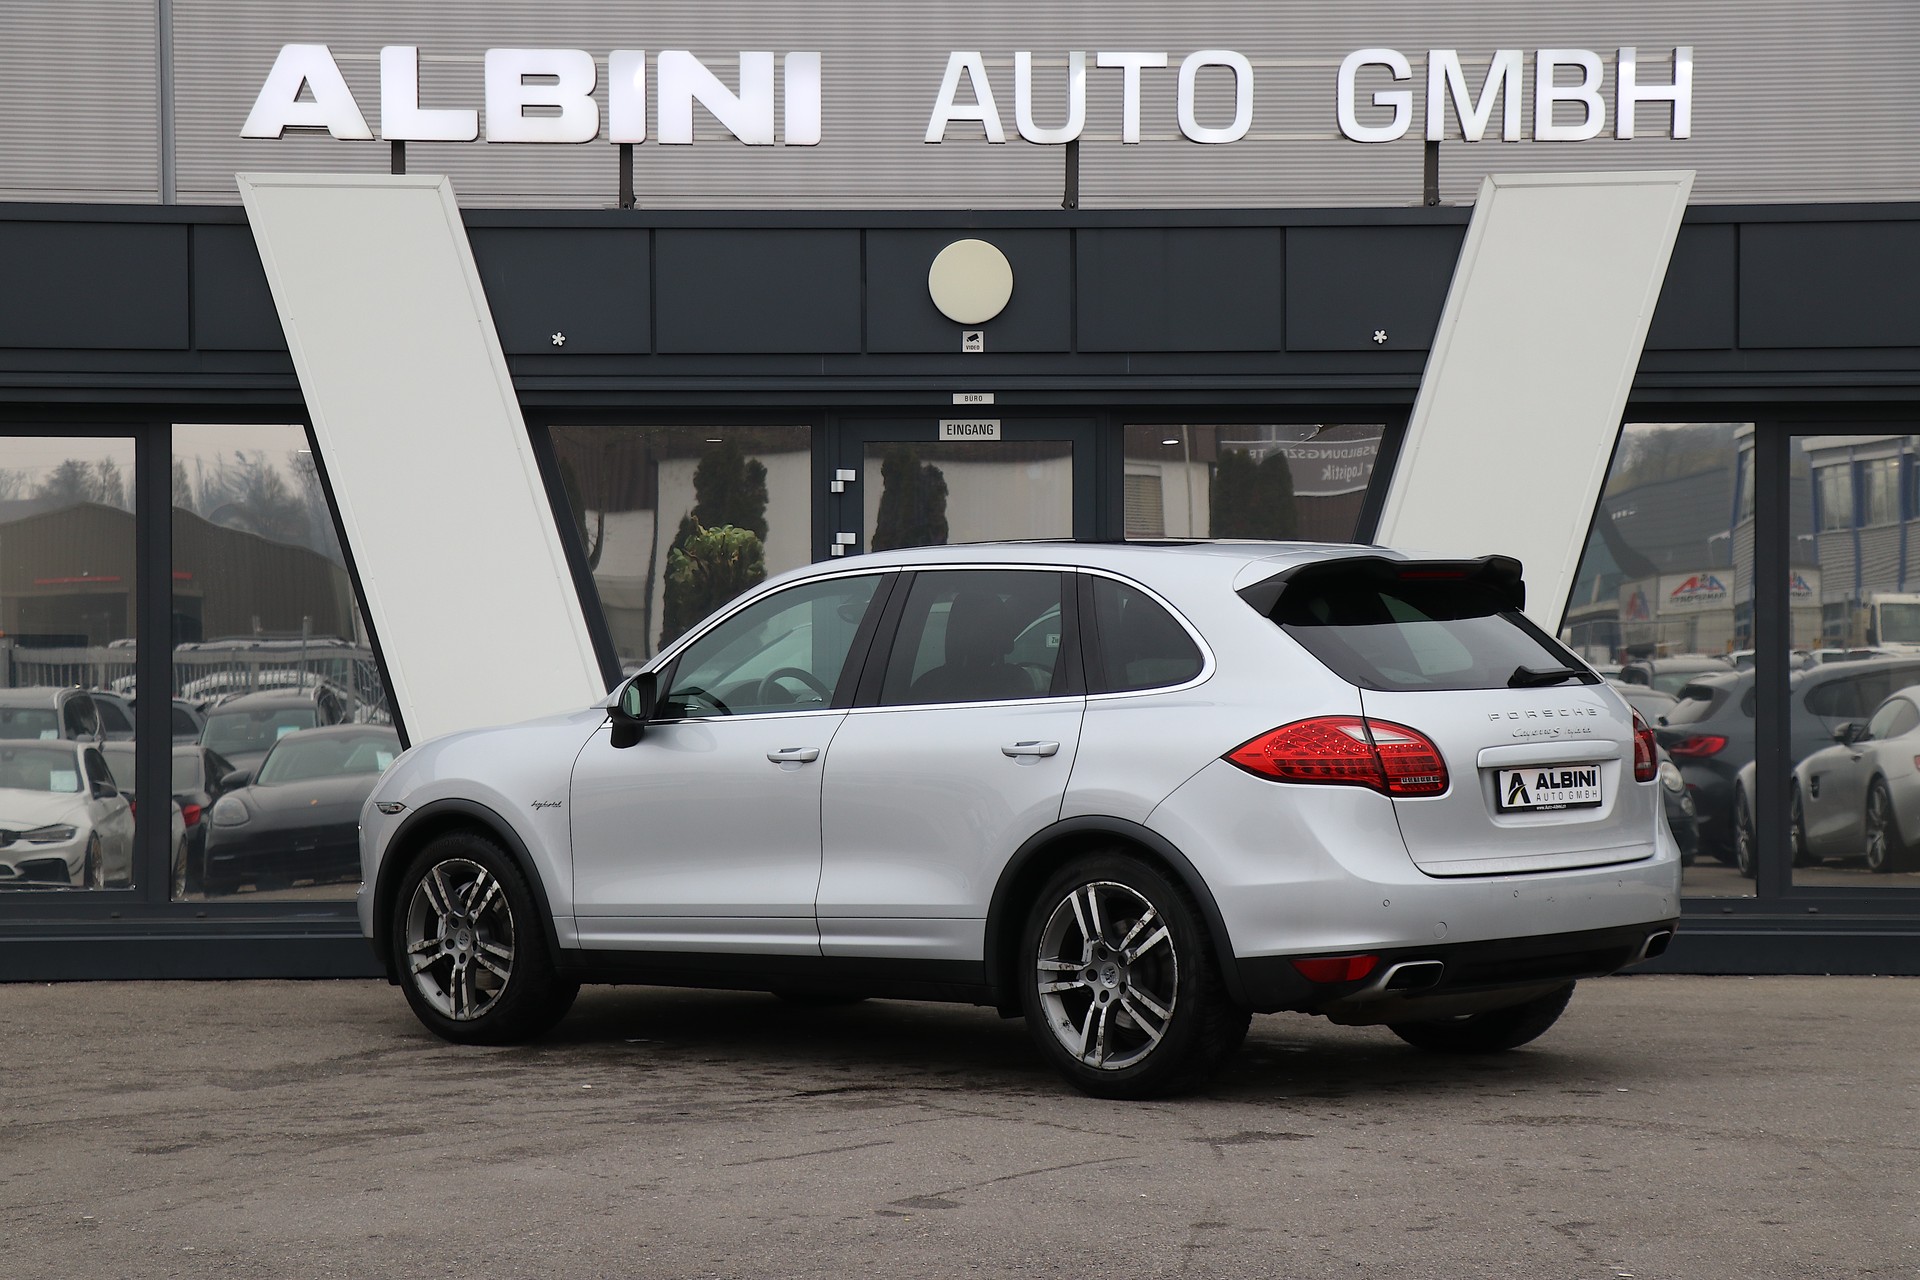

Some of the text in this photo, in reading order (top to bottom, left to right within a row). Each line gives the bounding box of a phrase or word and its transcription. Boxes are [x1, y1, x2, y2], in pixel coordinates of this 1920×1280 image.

[240, 43, 1693, 146] ALBINI AUTO GMBH
[964, 394, 983, 402] BÜRO
[946, 423, 994, 436] EINGANG
[1487, 707, 1598, 722] PORSCHE
[1535, 769, 1597, 790] ALBINI
[1536, 789, 1598, 802] AUTO GMBH
